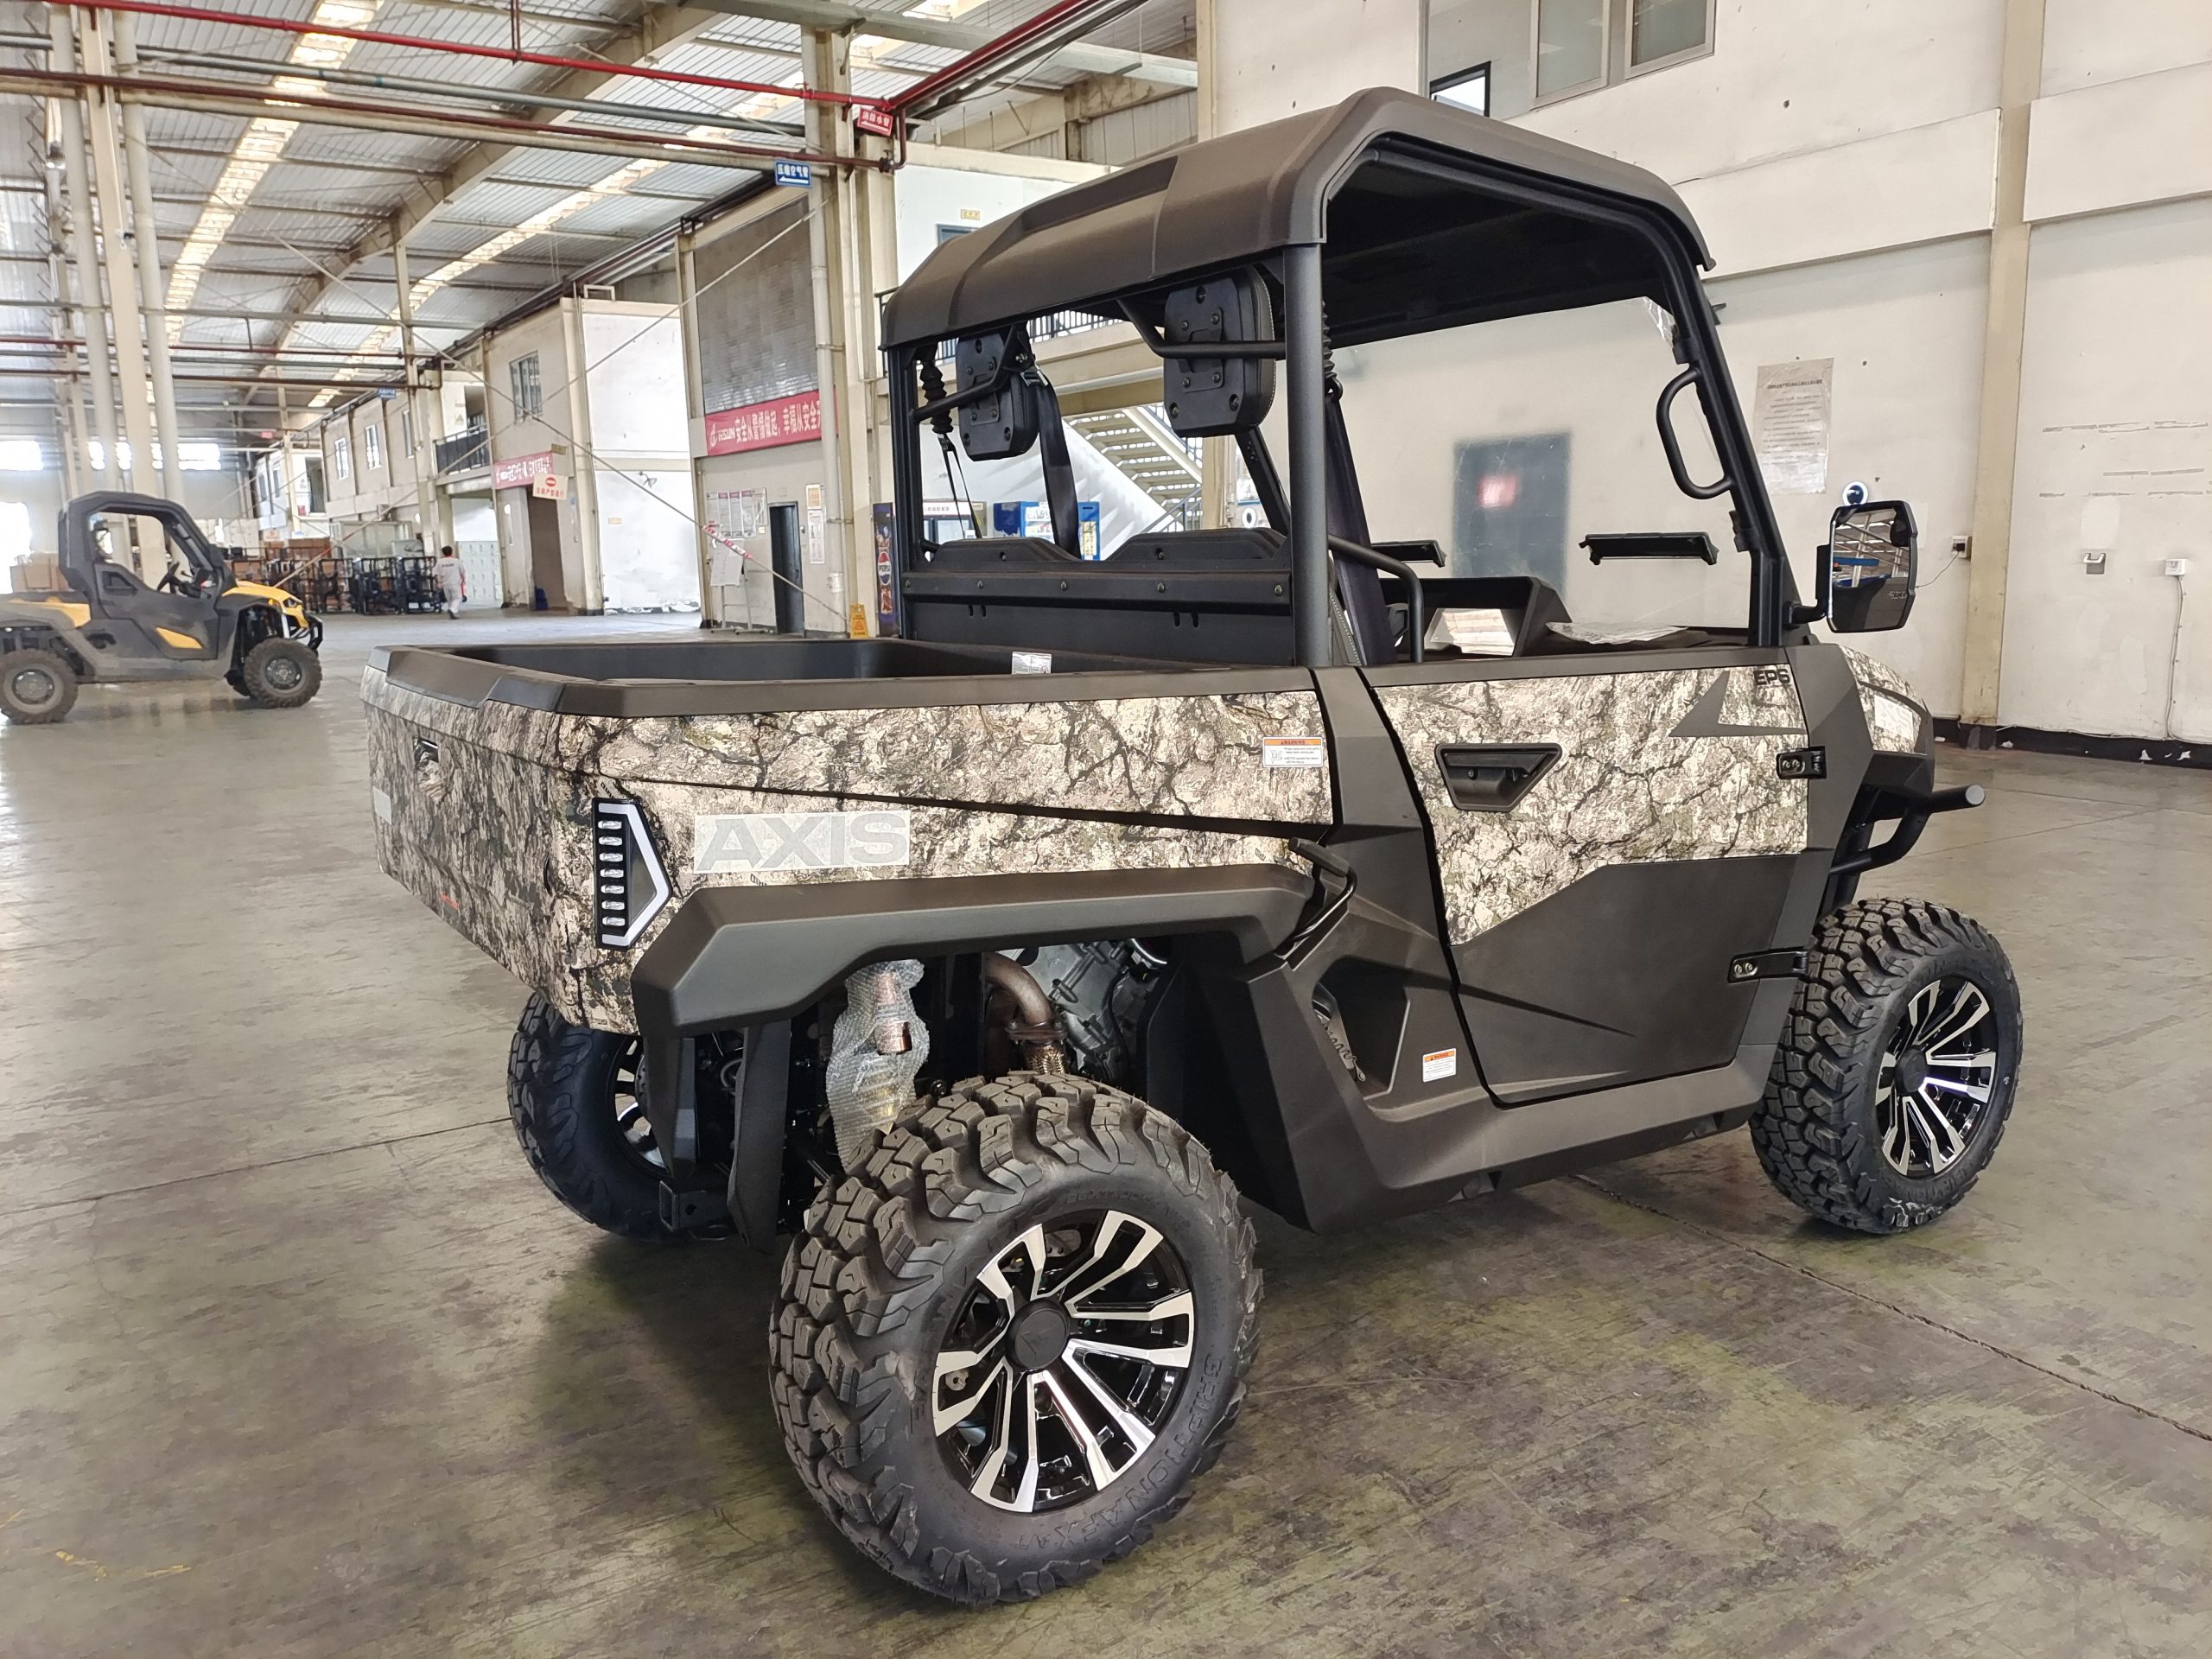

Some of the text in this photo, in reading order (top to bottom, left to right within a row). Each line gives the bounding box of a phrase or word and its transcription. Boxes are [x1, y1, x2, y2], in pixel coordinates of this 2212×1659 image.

[1753, 668, 1791, 686] EPS
[696, 813, 908, 871] AXIS
[1125, 1353, 1223, 1511] GRIPTION
